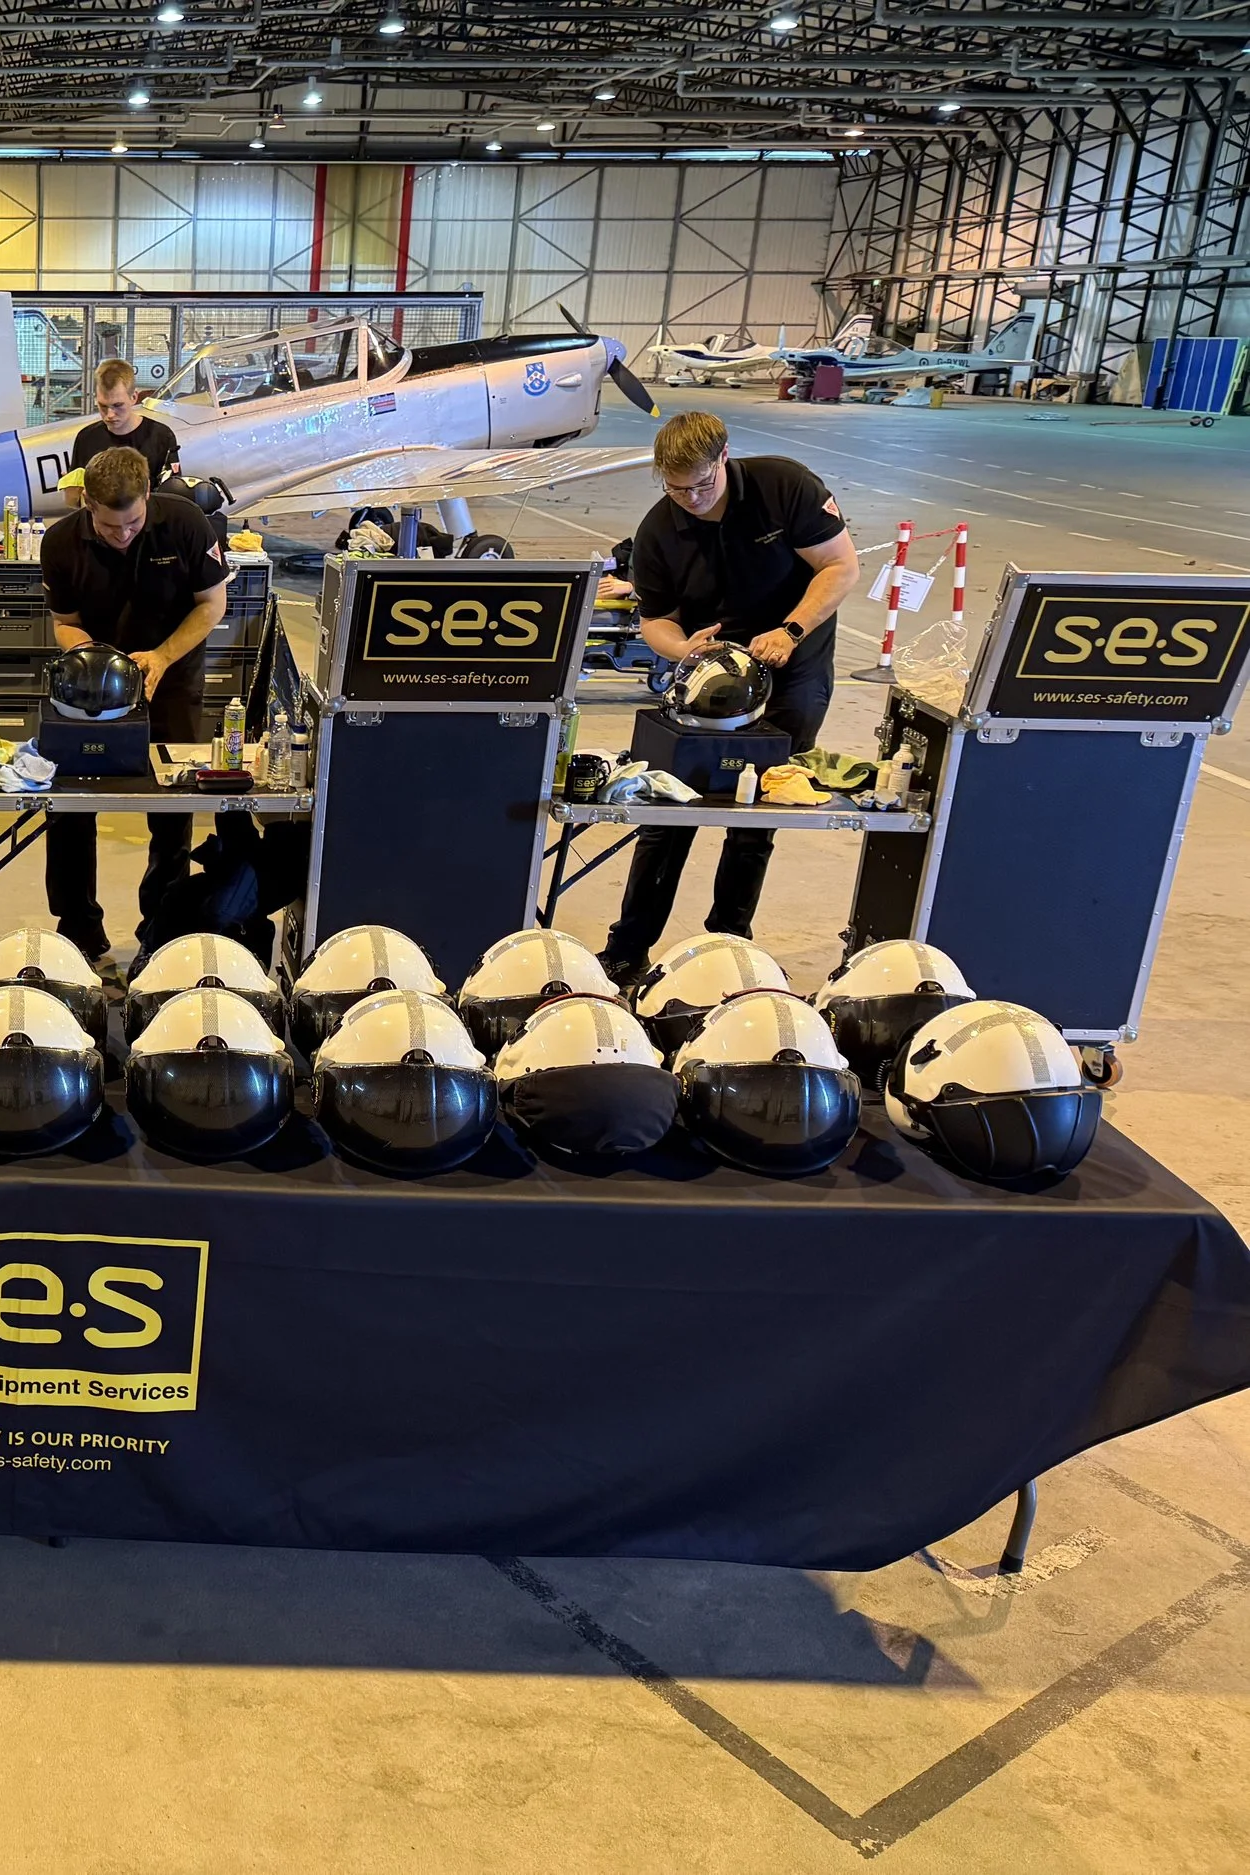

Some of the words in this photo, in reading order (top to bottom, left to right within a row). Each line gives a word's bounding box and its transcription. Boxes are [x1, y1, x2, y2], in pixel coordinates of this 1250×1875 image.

[383, 671, 530, 687] www.ses-safety.com
[1032, 691, 1189, 707] www.ses-safety.com
[87, 1379, 190, 1401] Services
[8, 1430, 24, 1446] IS
[30, 1431, 74, 1448] OUR
[80, 1433, 170, 1455] PRIORITY
